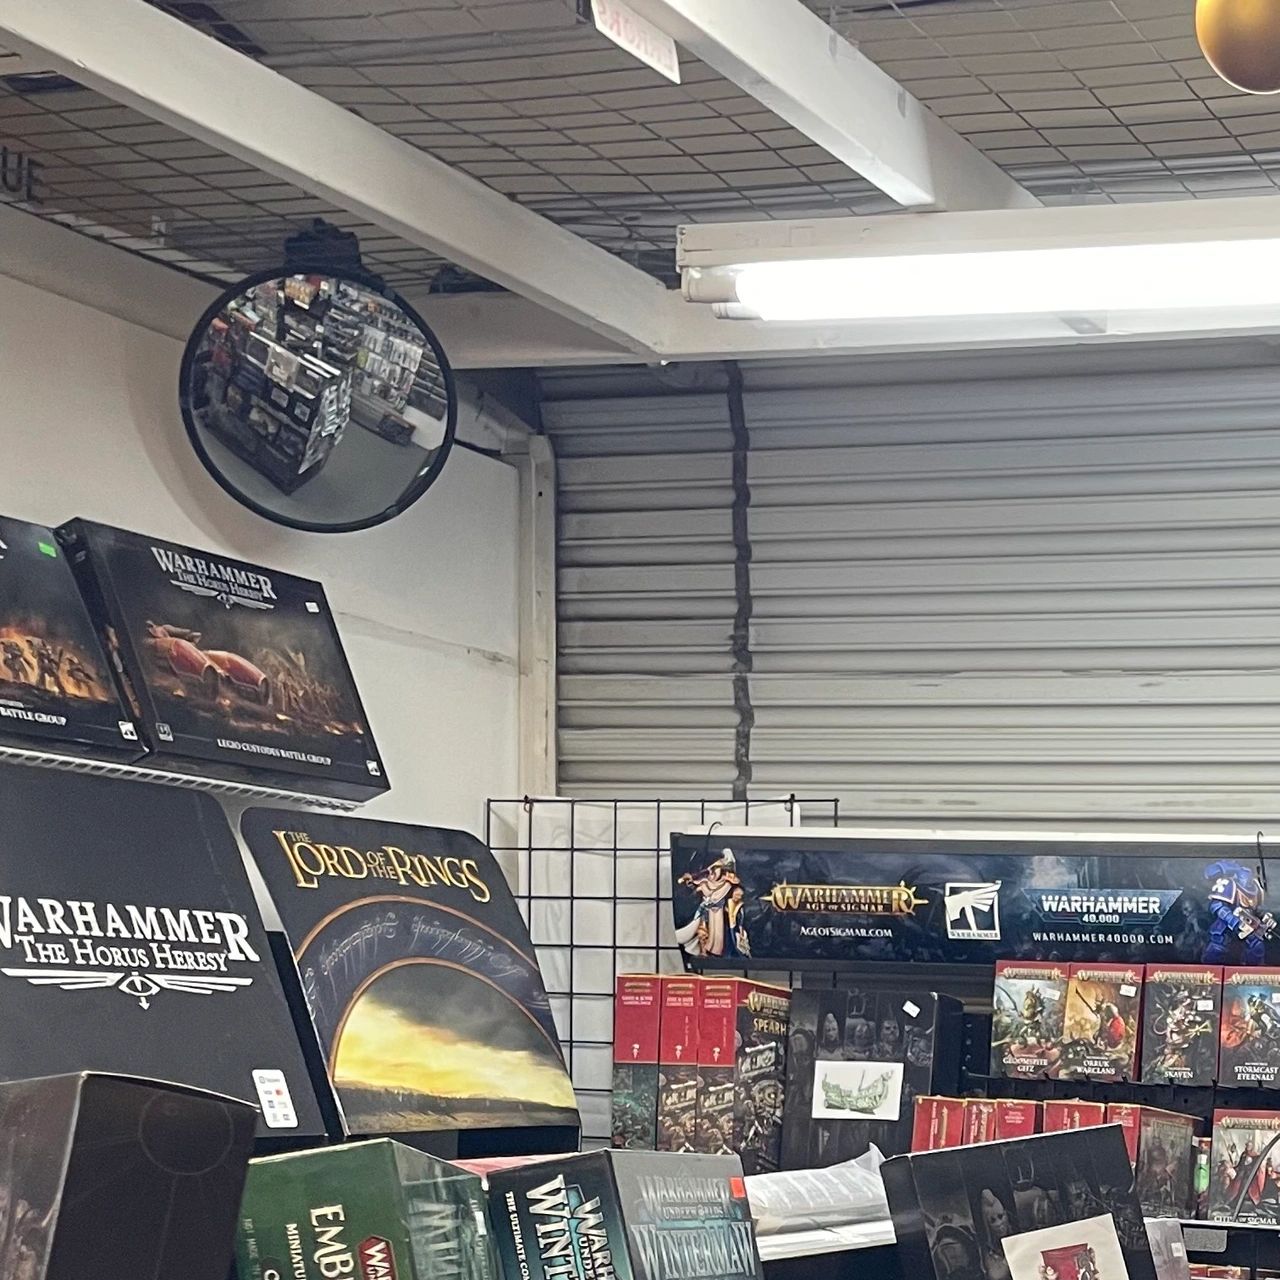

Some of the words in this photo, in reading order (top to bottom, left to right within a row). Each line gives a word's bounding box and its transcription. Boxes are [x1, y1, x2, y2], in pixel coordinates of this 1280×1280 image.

[151, 547, 277, 600] WARHAMMER
[0, 708, 34, 722] BATTLE
[34, 711, 67, 726] GROUP
[217, 738, 242, 750] LEGIO
[280, 747, 307, 761] BATTLE
[306, 751, 332, 765] GROUP
[289, 831, 311, 844] THE
[273, 830, 367, 888] LORD
[367, 850, 386, 866] OF
[394, 845, 491, 904] RINGS
[368, 864, 398, 881] THE
[774, 886, 913, 914] WARHAMMER
[1041, 895, 1160, 914] WARHAMMER
[805, 903, 825, 911] AGE
[840, 903, 884, 912] SIGMAR
[1033, 932, 1174, 944] WARHAMMER40000.COM
[16, 936, 66, 964] THE
[73, 938, 150, 968] HORUS
[155, 945, 229, 972] HERESY
[1002, 1056, 1048, 1066] GLOOMSPITE
[1083, 1060, 1110, 1068] ORRUK
[1017, 1064, 1034, 1073] GITZ
[1076, 1066, 1115, 1076] WARCLANS
[1164, 1070, 1194, 1080] SKAVEN
[1234, 1065, 1279, 1075] STORMCAST
[1237, 1072, 1275, 1082] ETERNALS
[504, 1191, 517, 1215] THE
[1247, 1217, 1278, 1226] SIGMAR
[509, 1214, 525, 1263] ULTIMATE
